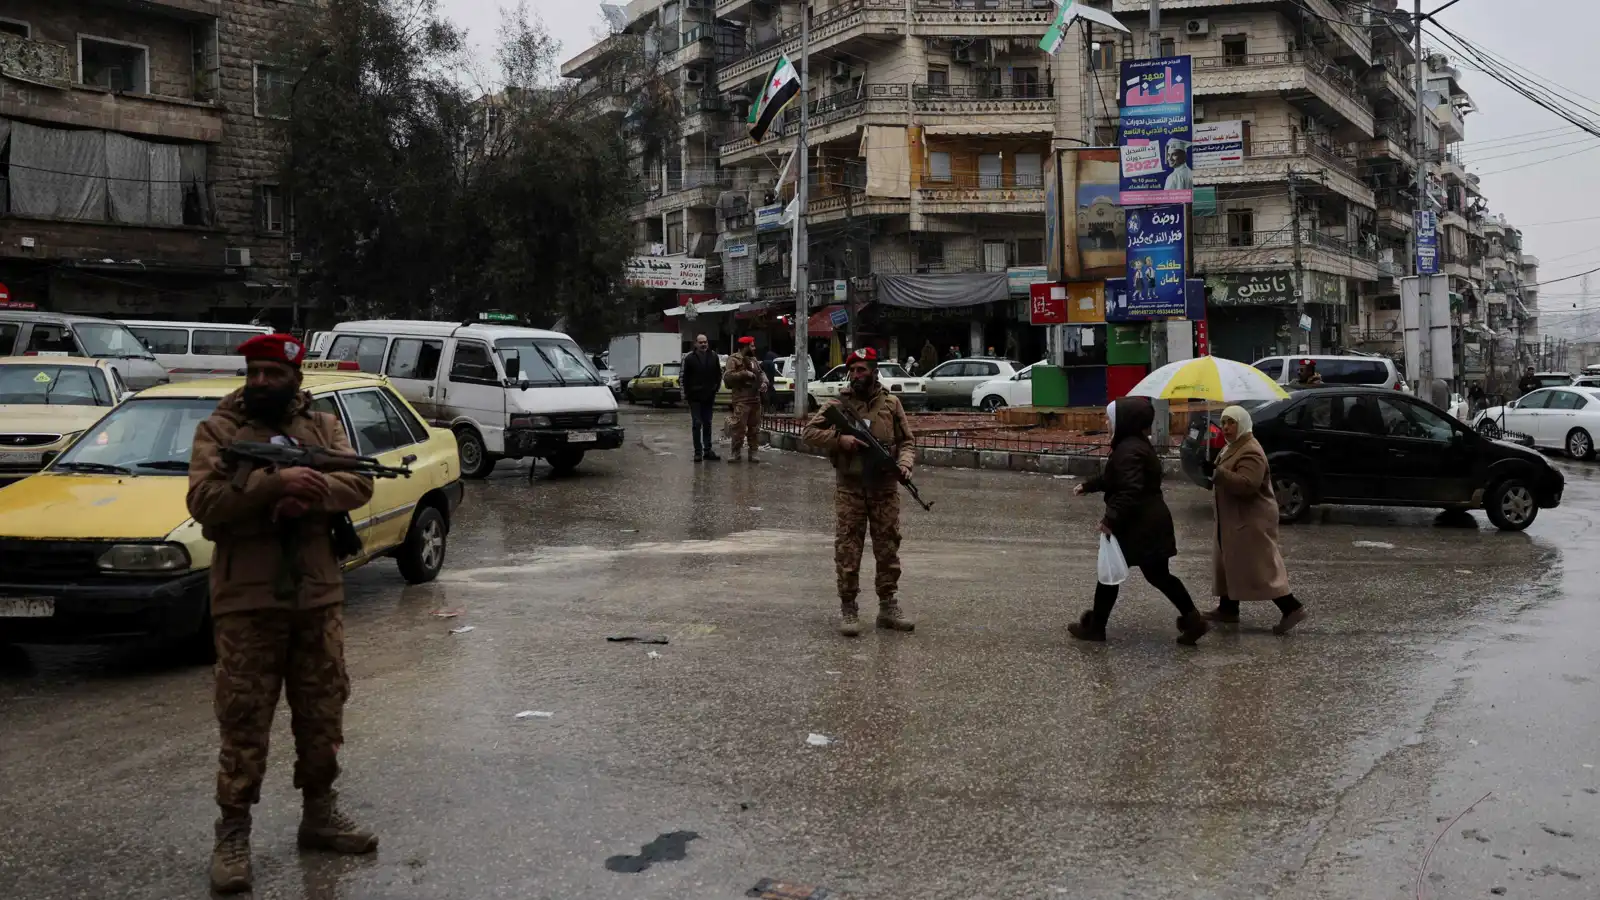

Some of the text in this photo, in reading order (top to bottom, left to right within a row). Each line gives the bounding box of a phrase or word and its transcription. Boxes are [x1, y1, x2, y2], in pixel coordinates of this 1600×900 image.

[1142, 72, 1165, 82] معهد
[1126, 115, 1186, 127] افتتاح التسجيل لدورات
[1123, 128, 1141, 138] التاسع
[1168, 125, 1189, 134] العلمي
[1125, 147, 1147, 156] التسجيل
[1125, 158, 1160, 173] 2027
[1151, 212, 1180, 226] روضة
[1127, 230, 1145, 248] كيدز
[1167, 229, 1183, 245] قطر
[679, 262, 704, 270] Syrian
[1155, 259, 1182, 271] طفلك
[1237, 276, 1286, 298] تاتش
